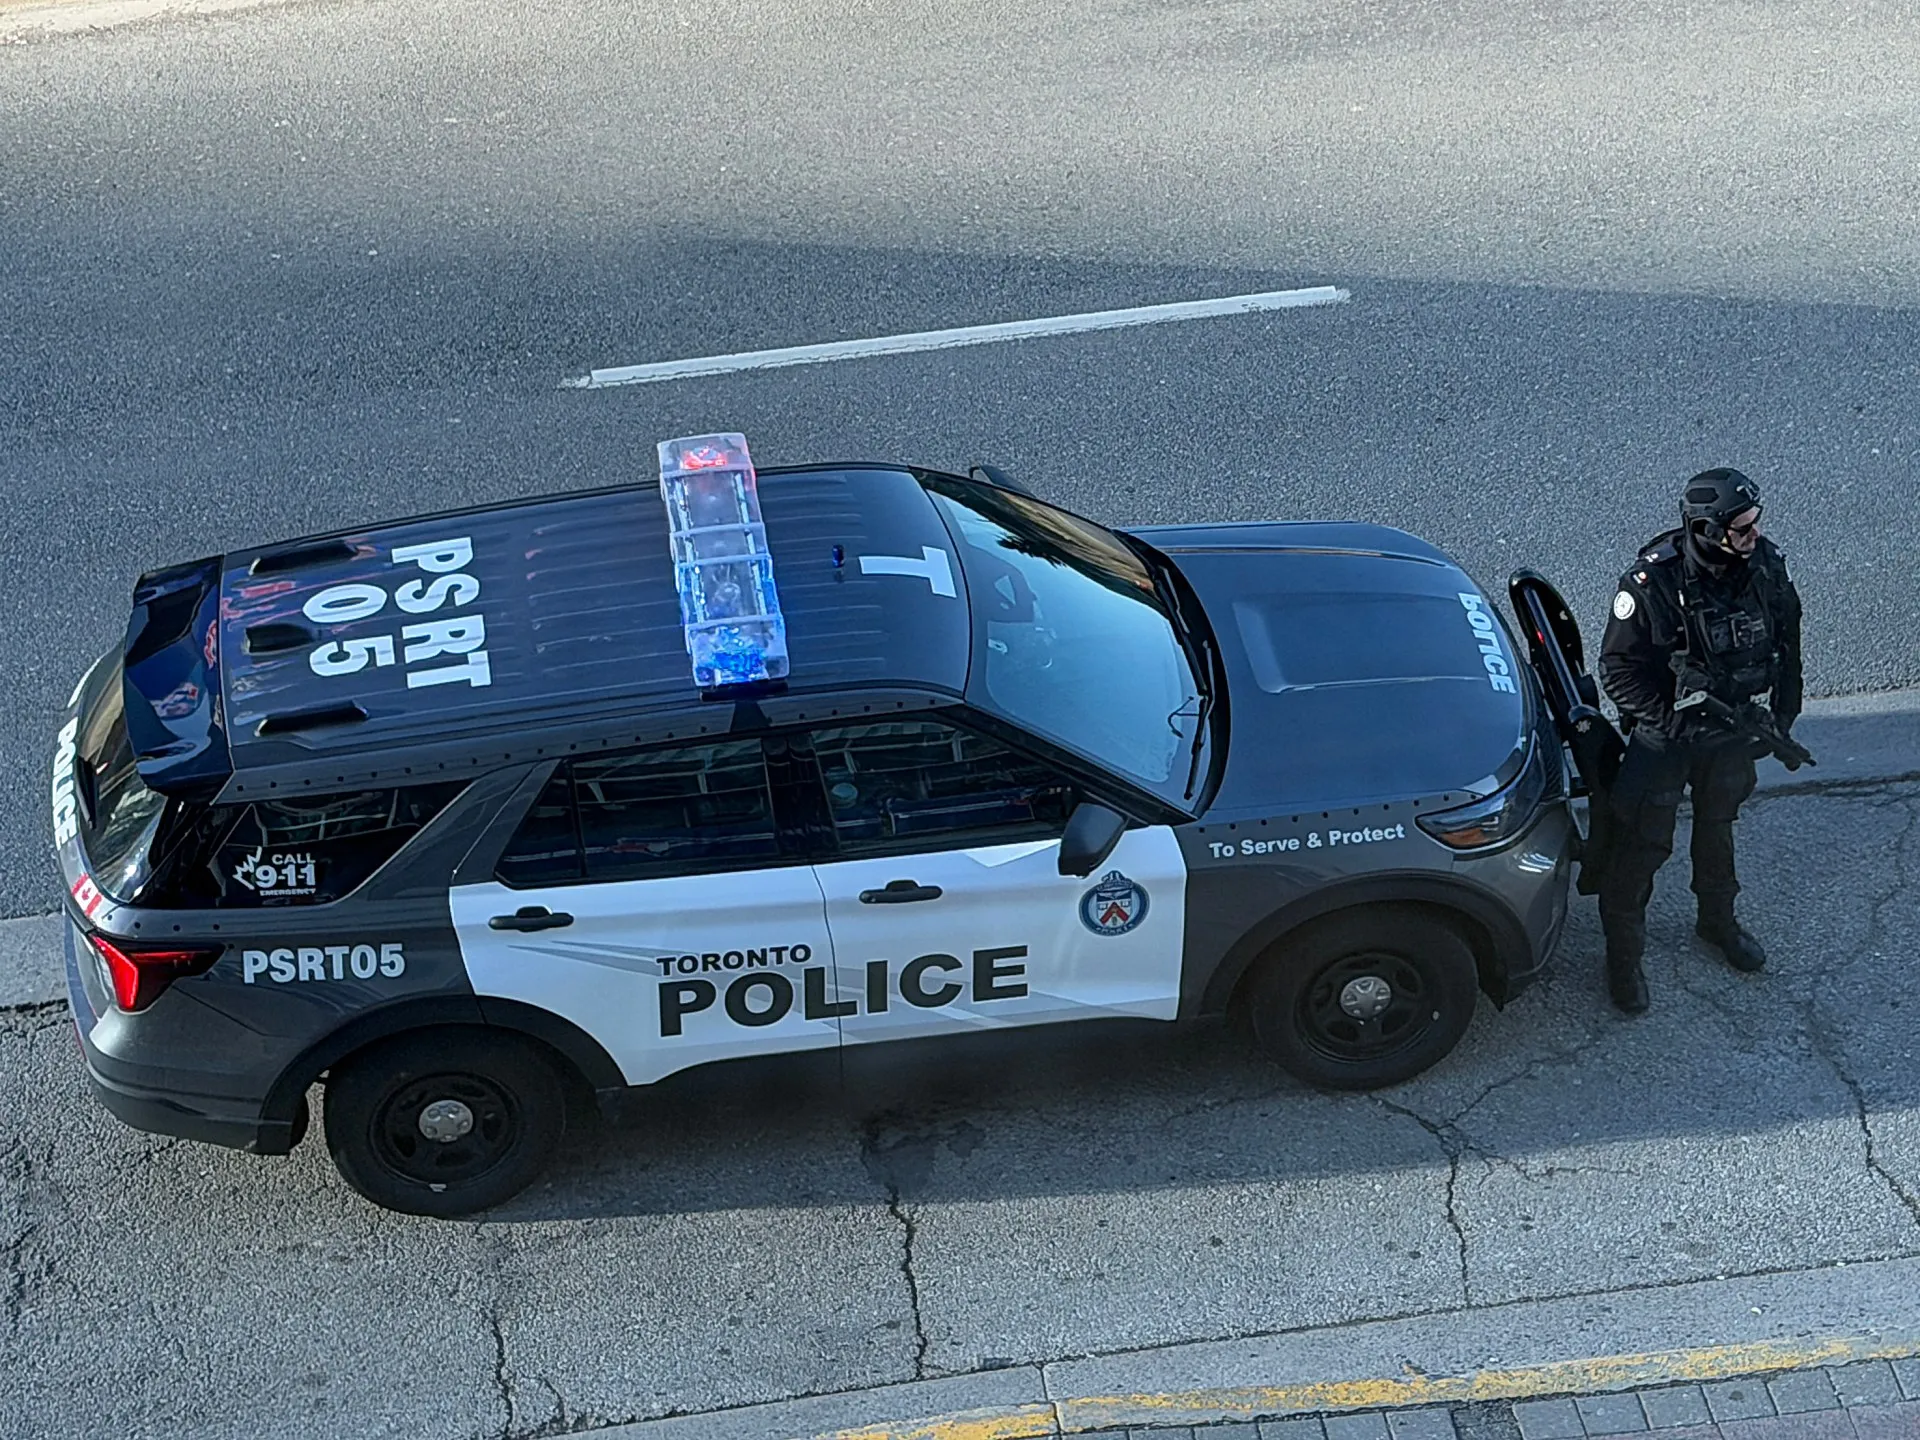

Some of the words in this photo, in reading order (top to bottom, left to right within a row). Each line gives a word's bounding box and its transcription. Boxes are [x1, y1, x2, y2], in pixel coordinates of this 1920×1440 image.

[302, 583, 395, 677] 05
[391, 536, 491, 689] PSRT
[53, 716, 79, 851] POLICE
[272, 852, 316, 865] CALL
[1208, 842, 1235, 858] To
[1241, 838, 1300, 855] Serve
[1306, 832, 1322, 849] &
[1329, 823, 1405, 846] Protect
[255, 864, 316, 888] 9-1-1
[242, 943, 406, 984] PSRT05
[656, 943, 812, 976] TORONTO
[657, 944, 1029, 1038] POLICE
